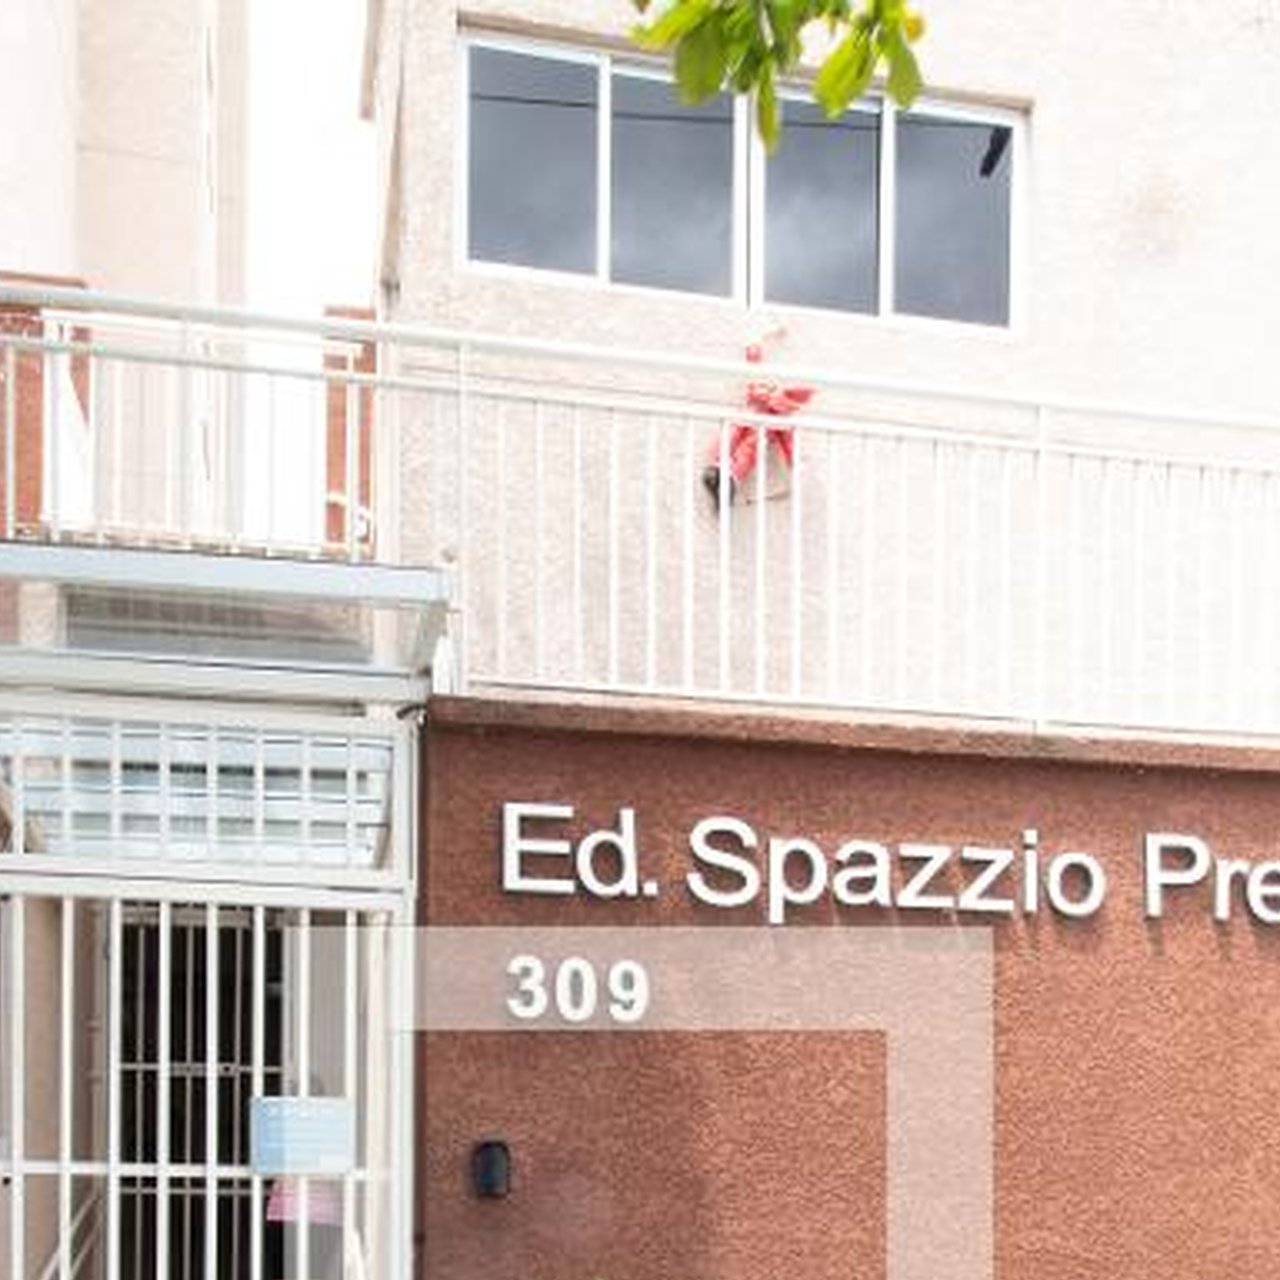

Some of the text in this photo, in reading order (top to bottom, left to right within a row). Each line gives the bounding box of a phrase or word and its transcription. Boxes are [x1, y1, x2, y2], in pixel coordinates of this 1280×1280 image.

[502, 802, 659, 898] Ed.
[686, 816, 1107, 924] Spazzio
[505, 955, 650, 1022] 309
